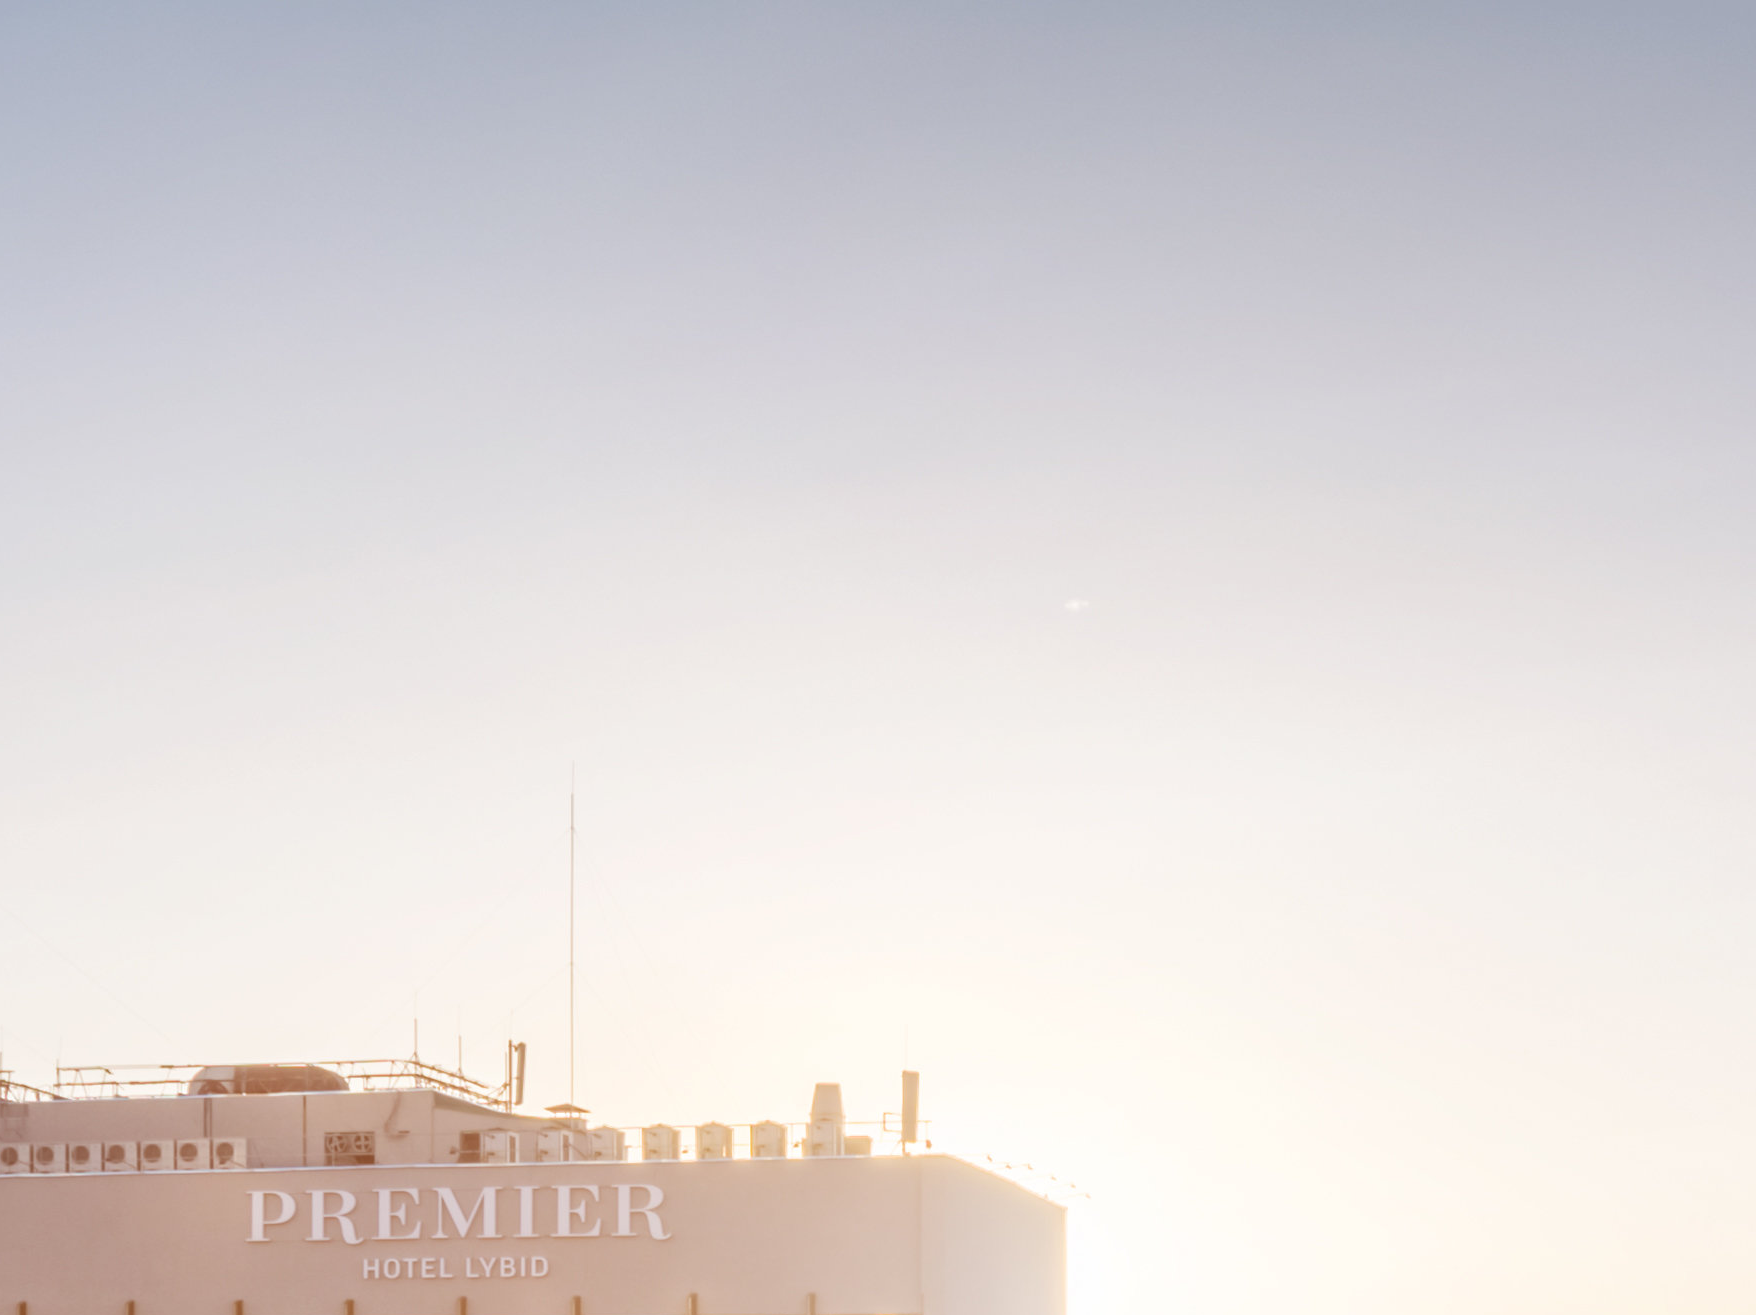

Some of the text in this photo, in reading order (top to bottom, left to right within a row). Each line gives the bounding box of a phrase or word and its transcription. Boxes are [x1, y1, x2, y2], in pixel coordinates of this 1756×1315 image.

[245, 1183, 672, 1245] PREMIER
[362, 1256, 549, 1279] HOTEL LYBID
